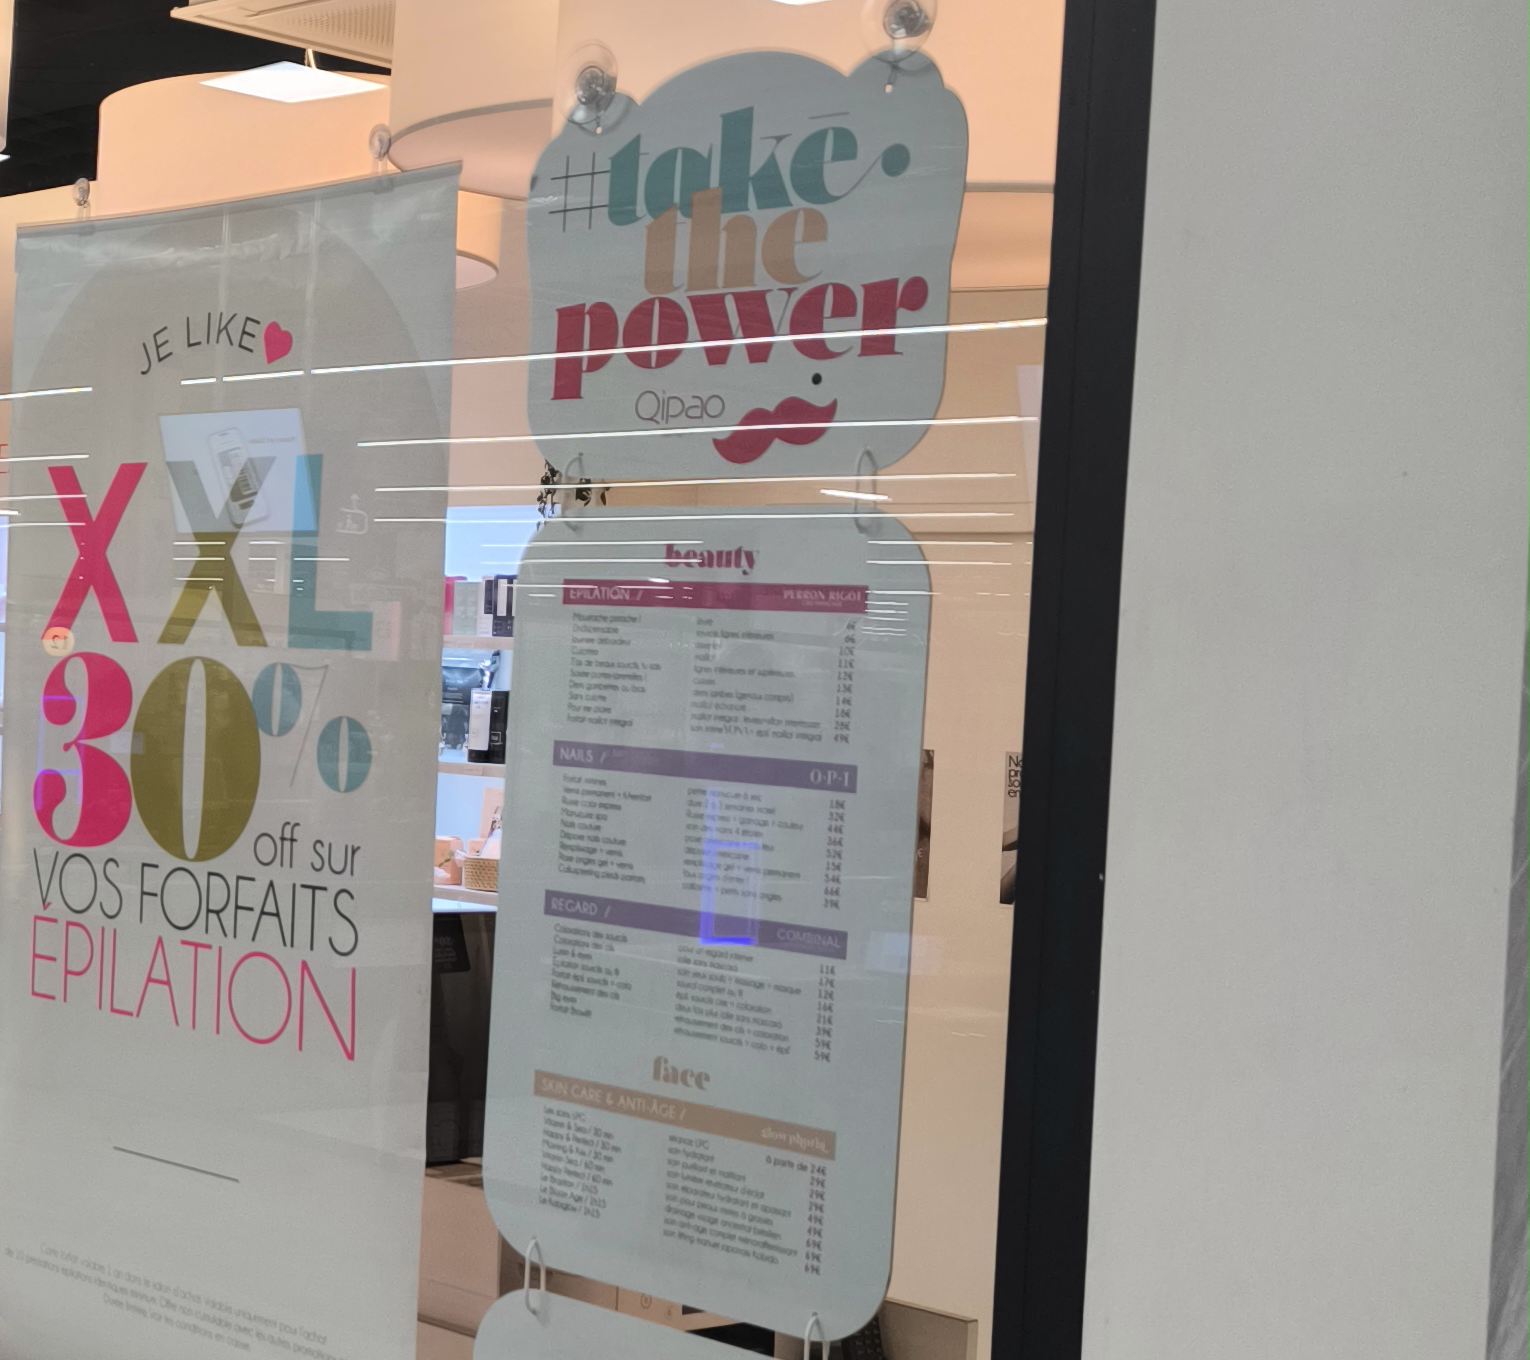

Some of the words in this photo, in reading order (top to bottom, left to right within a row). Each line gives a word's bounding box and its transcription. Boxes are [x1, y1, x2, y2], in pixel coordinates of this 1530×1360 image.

[644, 187, 828, 296] the
[140, 325, 173, 375] JE
[185, 311, 261, 353] LIKE
[551, 276, 928, 400] power
[635, 390, 725, 425] Qipao
[41, 454, 372, 652] XXL
[665, 543, 758, 576] beauty
[33, 651, 372, 863] 30%
[559, 747, 594, 763] NAILS
[253, 822, 302, 868] off
[310, 838, 360, 877] sur
[34, 847, 124, 920] VOS
[140, 862, 359, 957] FORFAITS
[551, 897, 598, 916] REGARD
[31, 902, 357, 1062] ÉPILATION
[570, 1084, 602, 1103] CARE
[652, 1055, 711, 1091] face
